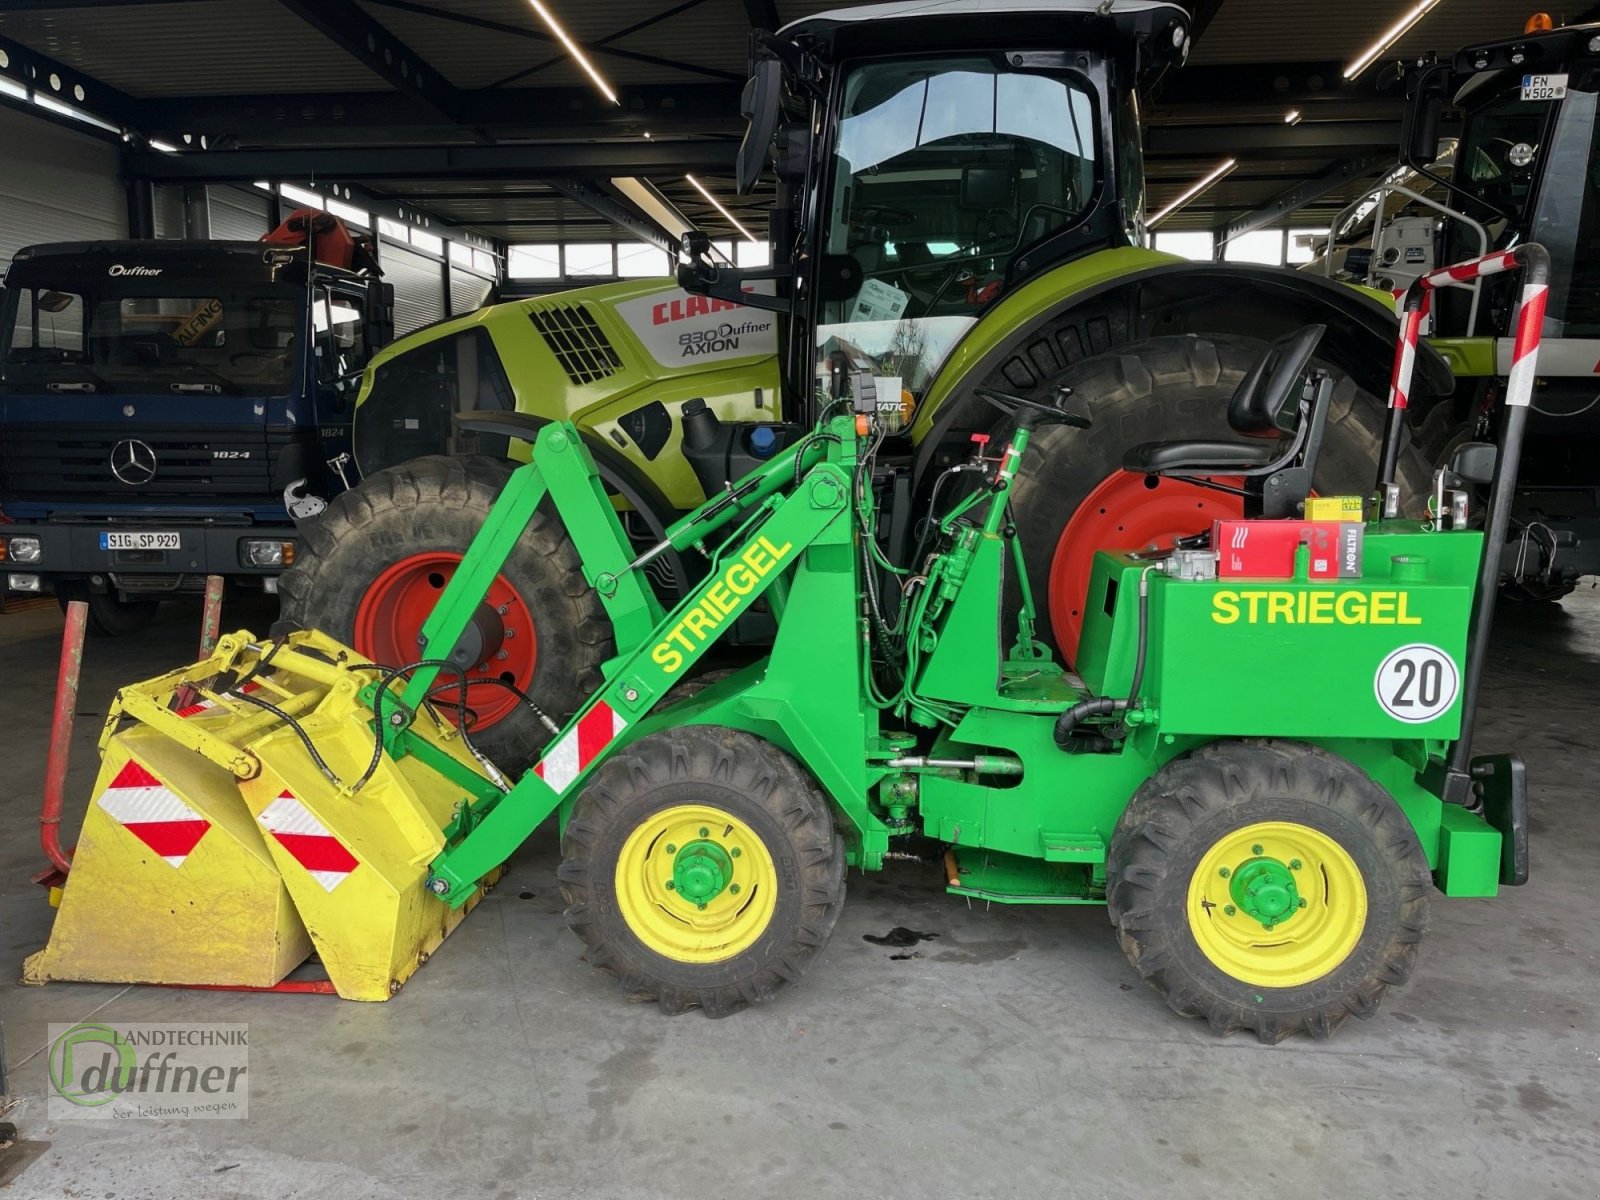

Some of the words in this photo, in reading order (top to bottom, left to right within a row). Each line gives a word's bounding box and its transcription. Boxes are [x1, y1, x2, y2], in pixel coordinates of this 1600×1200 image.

[1533, 76, 1549, 87] FN
[1524, 88, 1532, 99] W
[1532, 88, 1554, 99] 502
[108, 263, 162, 276] Duffner
[652, 287, 754, 326] CLAA
[678, 329, 718, 346] 830
[718, 321, 772, 338] Duffner
[681, 337, 740, 358] AXION
[212, 450, 250, 460] 1824
[109, 534, 132, 548] SIG
[139, 533, 154, 547] SP
[157, 533, 178, 547] 929
[1345, 528, 1358, 572] FILTRON
[651, 535, 793, 674] STRIEGEL
[1211, 590, 1422, 625] STRIEGEL
[1391, 658, 1443, 708] 20
